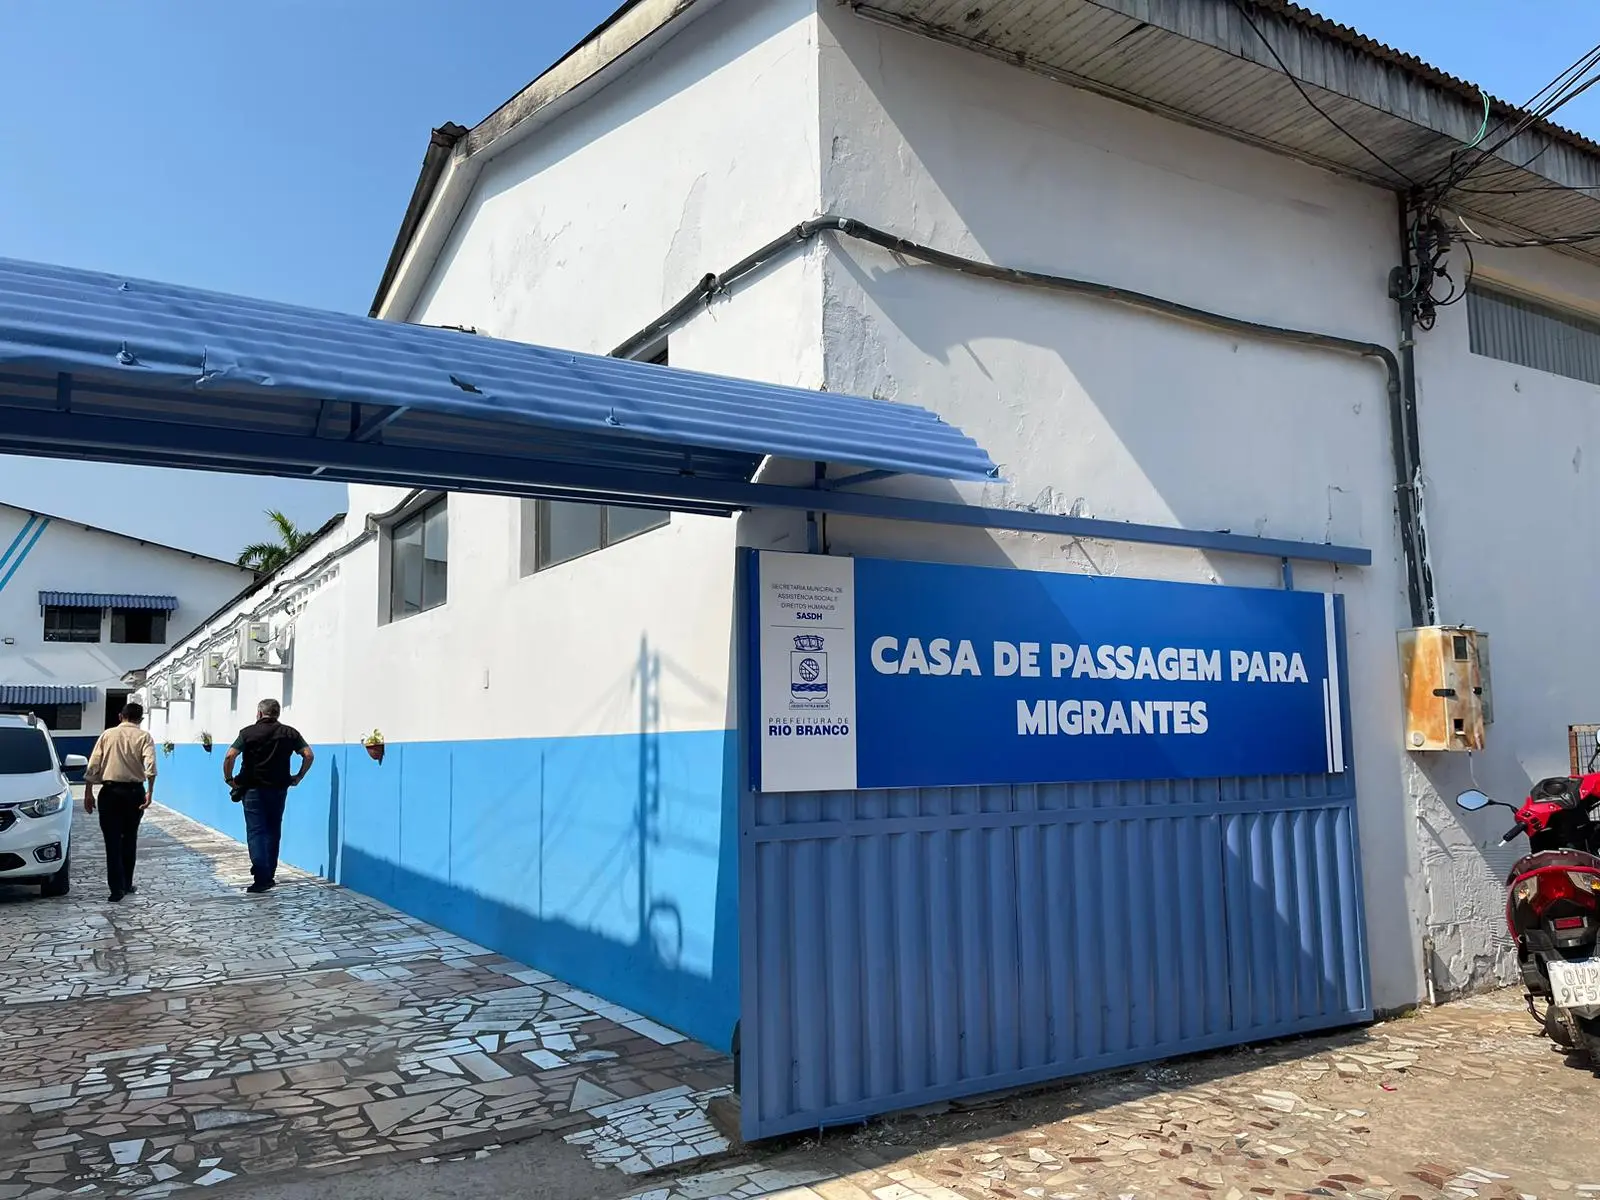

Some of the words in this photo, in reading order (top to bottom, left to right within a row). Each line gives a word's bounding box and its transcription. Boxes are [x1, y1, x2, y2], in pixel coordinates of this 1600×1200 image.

[772, 583, 806, 591] SECRETARIA
[806, 585, 834, 593] MUNICIPAL
[796, 612, 823, 620] SASDH
[870, 635, 981, 676] CASA
[993, 641, 1040, 678] DE
[1051, 643, 1222, 682] PASSAGEM
[1230, 650, 1309, 683] PARA
[1016, 699, 1209, 736] MIGRANTES
[768, 725, 792, 736] RIO
[795, 725, 849, 736] BRANCO
[1561, 984, 1600, 1003] 9F5
